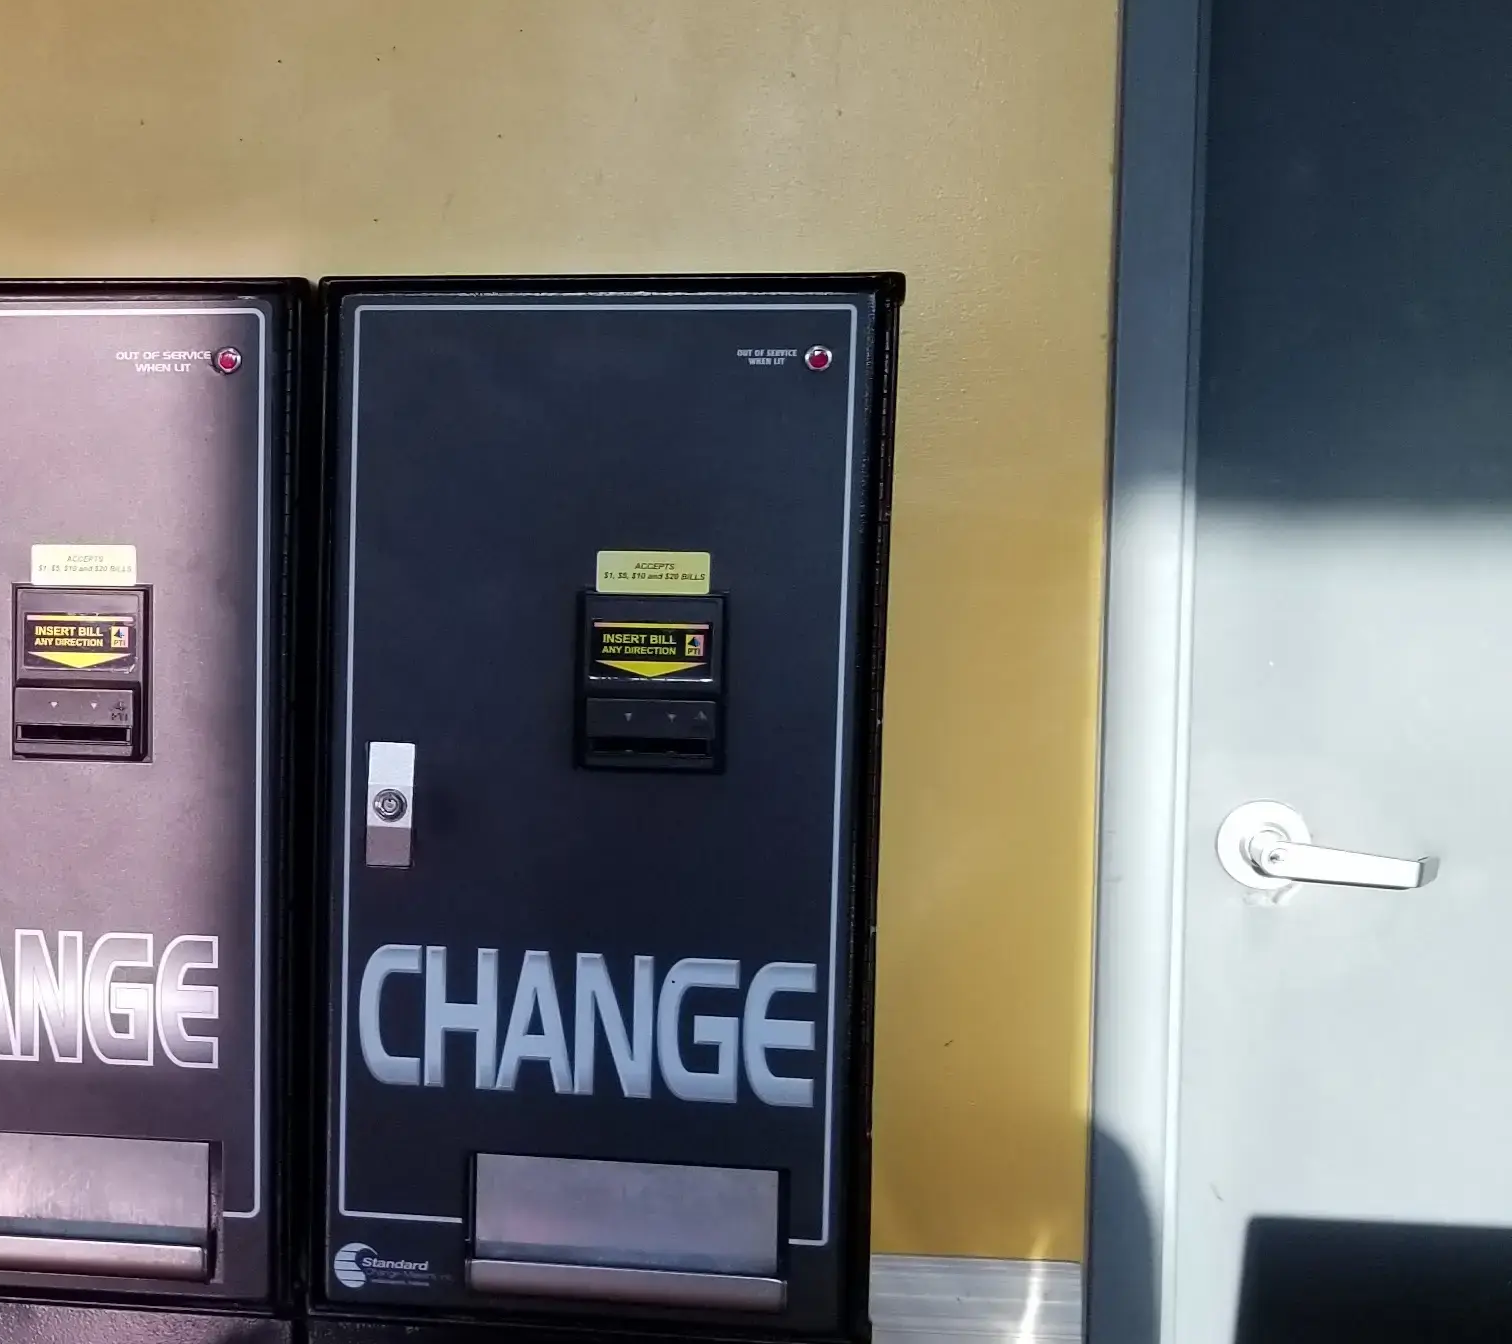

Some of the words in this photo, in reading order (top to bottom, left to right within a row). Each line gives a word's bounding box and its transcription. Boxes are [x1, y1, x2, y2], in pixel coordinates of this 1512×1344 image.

[116, 351, 139, 360] OUT
[143, 351, 160, 360] OF
[163, 351, 211, 360] SERVICE
[767, 349, 797, 357] SERVICE
[135, 363, 171, 372] WHEN
[174, 363, 191, 372] LIT
[35, 626, 76, 636] INSERT
[78, 626, 104, 636] BILL
[34, 637, 54, 646] ANY
[55, 638, 104, 647] DIRECTION
[602, 634, 648, 644] INSERT
[649, 634, 677, 645] BILL
[602, 646, 622, 654] ANY
[624, 646, 677, 655] DIRECTION
[360, 943, 820, 1108] CHANGE
[361, 1257, 429, 1271] Standard
